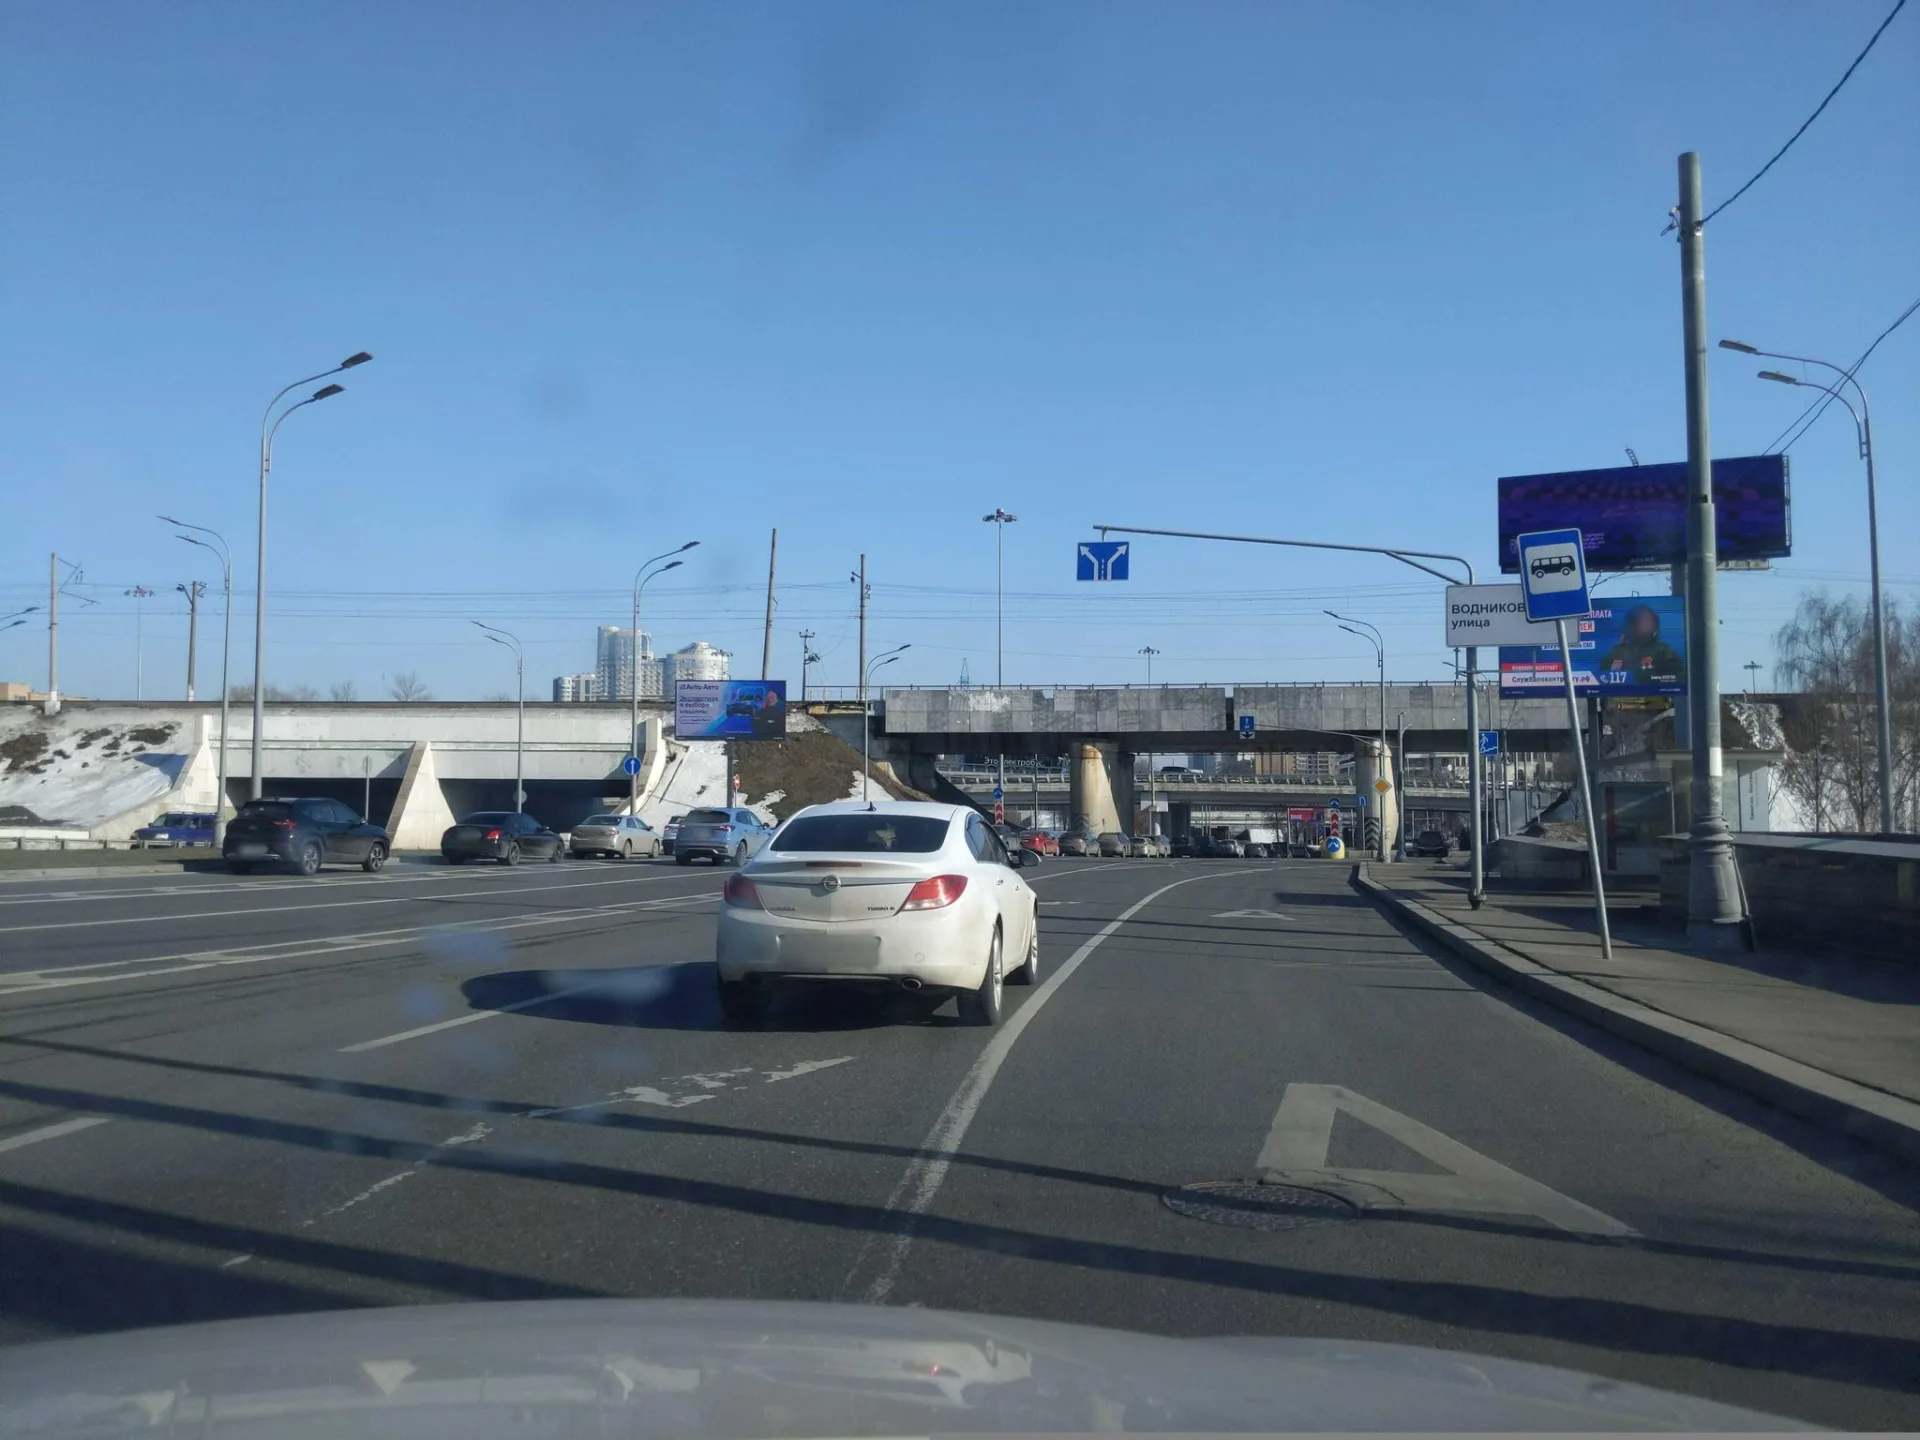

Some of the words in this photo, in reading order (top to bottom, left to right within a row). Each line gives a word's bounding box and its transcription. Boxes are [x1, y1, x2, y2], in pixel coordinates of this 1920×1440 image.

[1451, 602, 1526, 615] ВОДНИКОВ
[1451, 619, 1490, 630] улица
[1609, 672, 1627, 684] 117
[984, 756, 999, 765] Это
